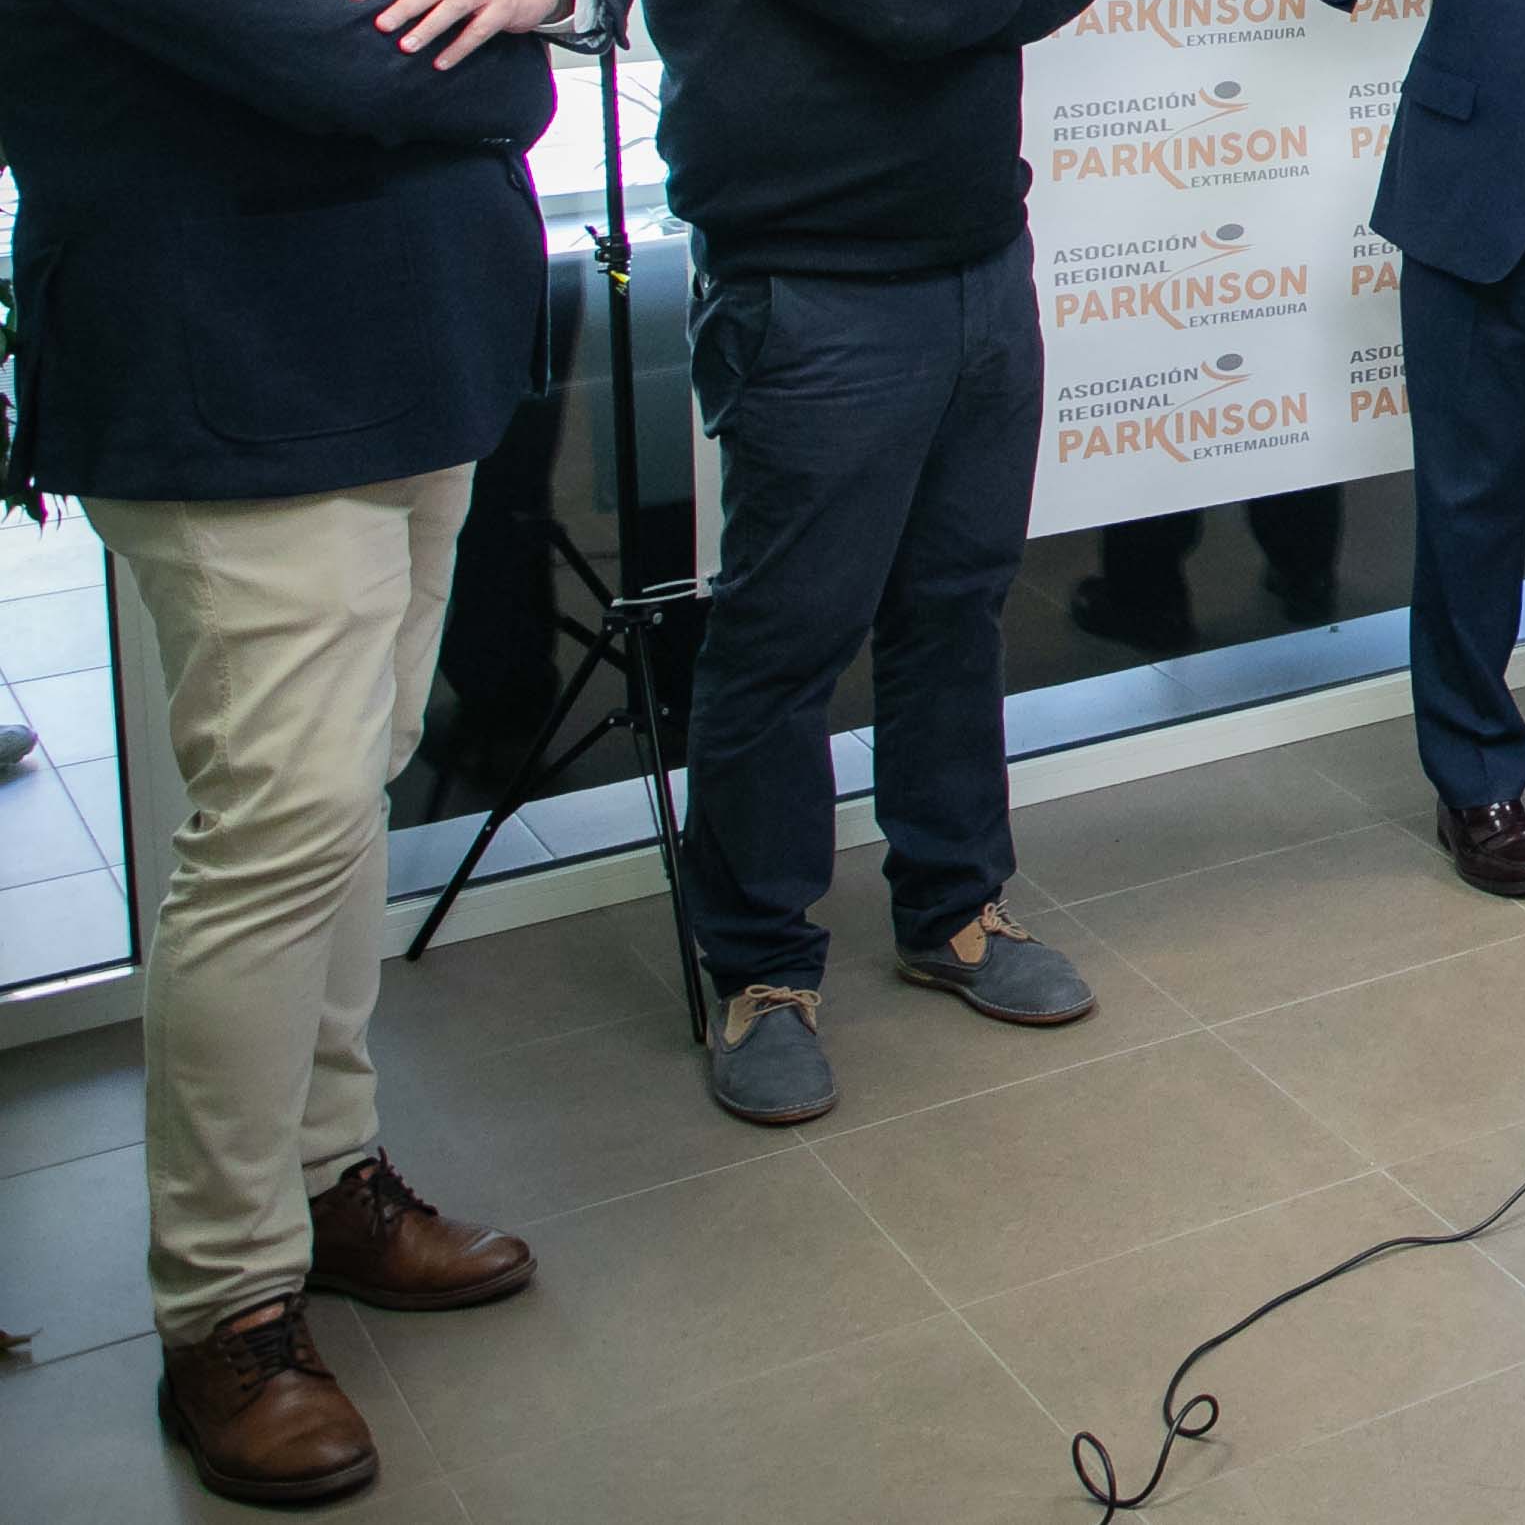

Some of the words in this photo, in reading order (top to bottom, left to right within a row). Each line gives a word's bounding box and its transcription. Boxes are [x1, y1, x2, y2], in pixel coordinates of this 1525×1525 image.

[1186, 26, 1307, 47] EXTREMADURA
[1053, 91, 1197, 120] ASOCIACIÓN
[1052, 117, 1174, 143] REGIONAL
[1051, 125, 1309, 190] PARKINSON
[1190, 164, 1310, 189] EXTREMADURA
[1053, 234, 1198, 265] ASOCIACIÓN
[1053, 259, 1172, 287] REGIONAL
[1055, 264, 1308, 330] PARKINSON
[1188, 302, 1309, 328] EXTREMADURA
[1057, 366, 1200, 402] ASOCIACIÓN
[1058, 392, 1176, 424] REGIONAL
[1057, 392, 1309, 464] PARKINSON
[1193, 430, 1311, 461] EXTREMADURA
